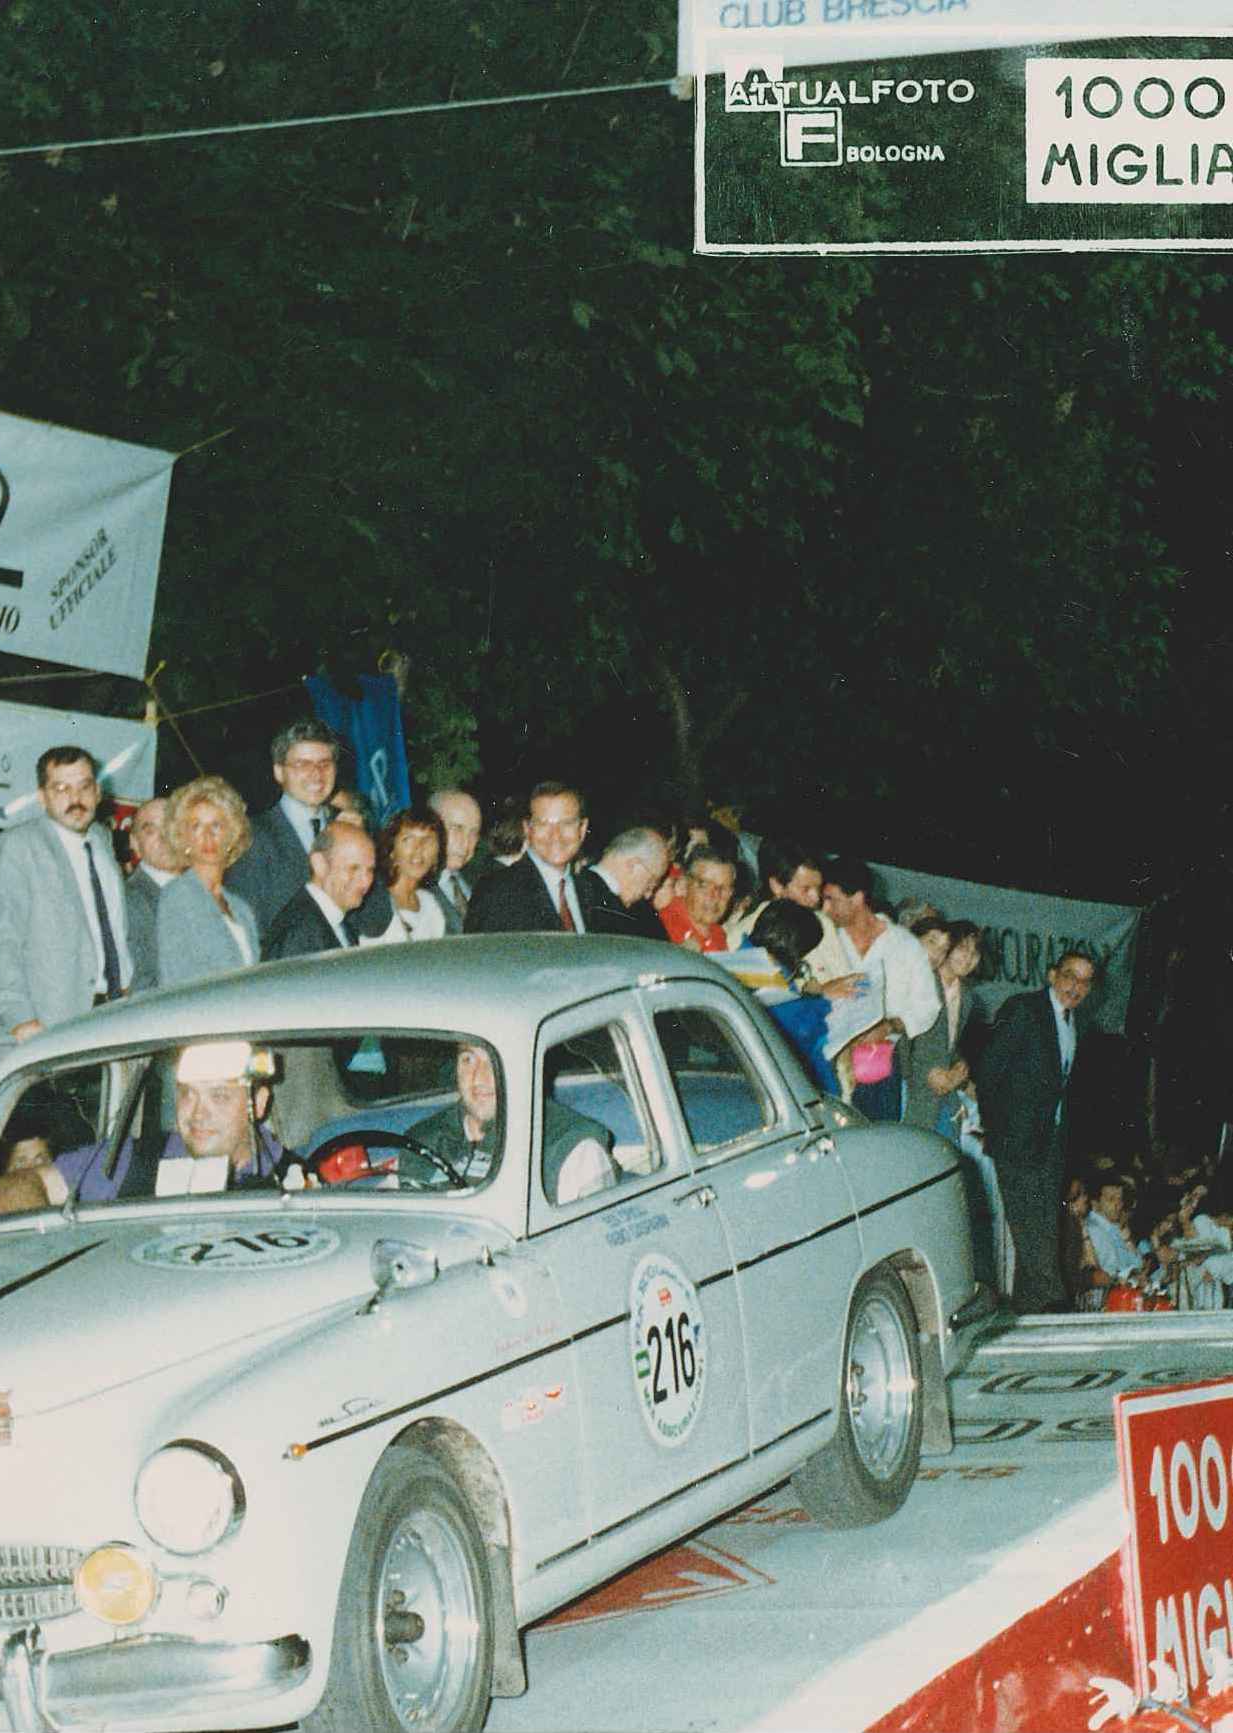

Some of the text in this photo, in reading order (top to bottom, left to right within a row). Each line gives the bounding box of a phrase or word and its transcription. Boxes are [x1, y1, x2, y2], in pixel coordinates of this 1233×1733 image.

[719, 0, 806, 28] CLUB
[174, 1231, 311, 1264] 216
[647, 1311, 696, 1405] 216
[1150, 1433, 1233, 1544] 100
